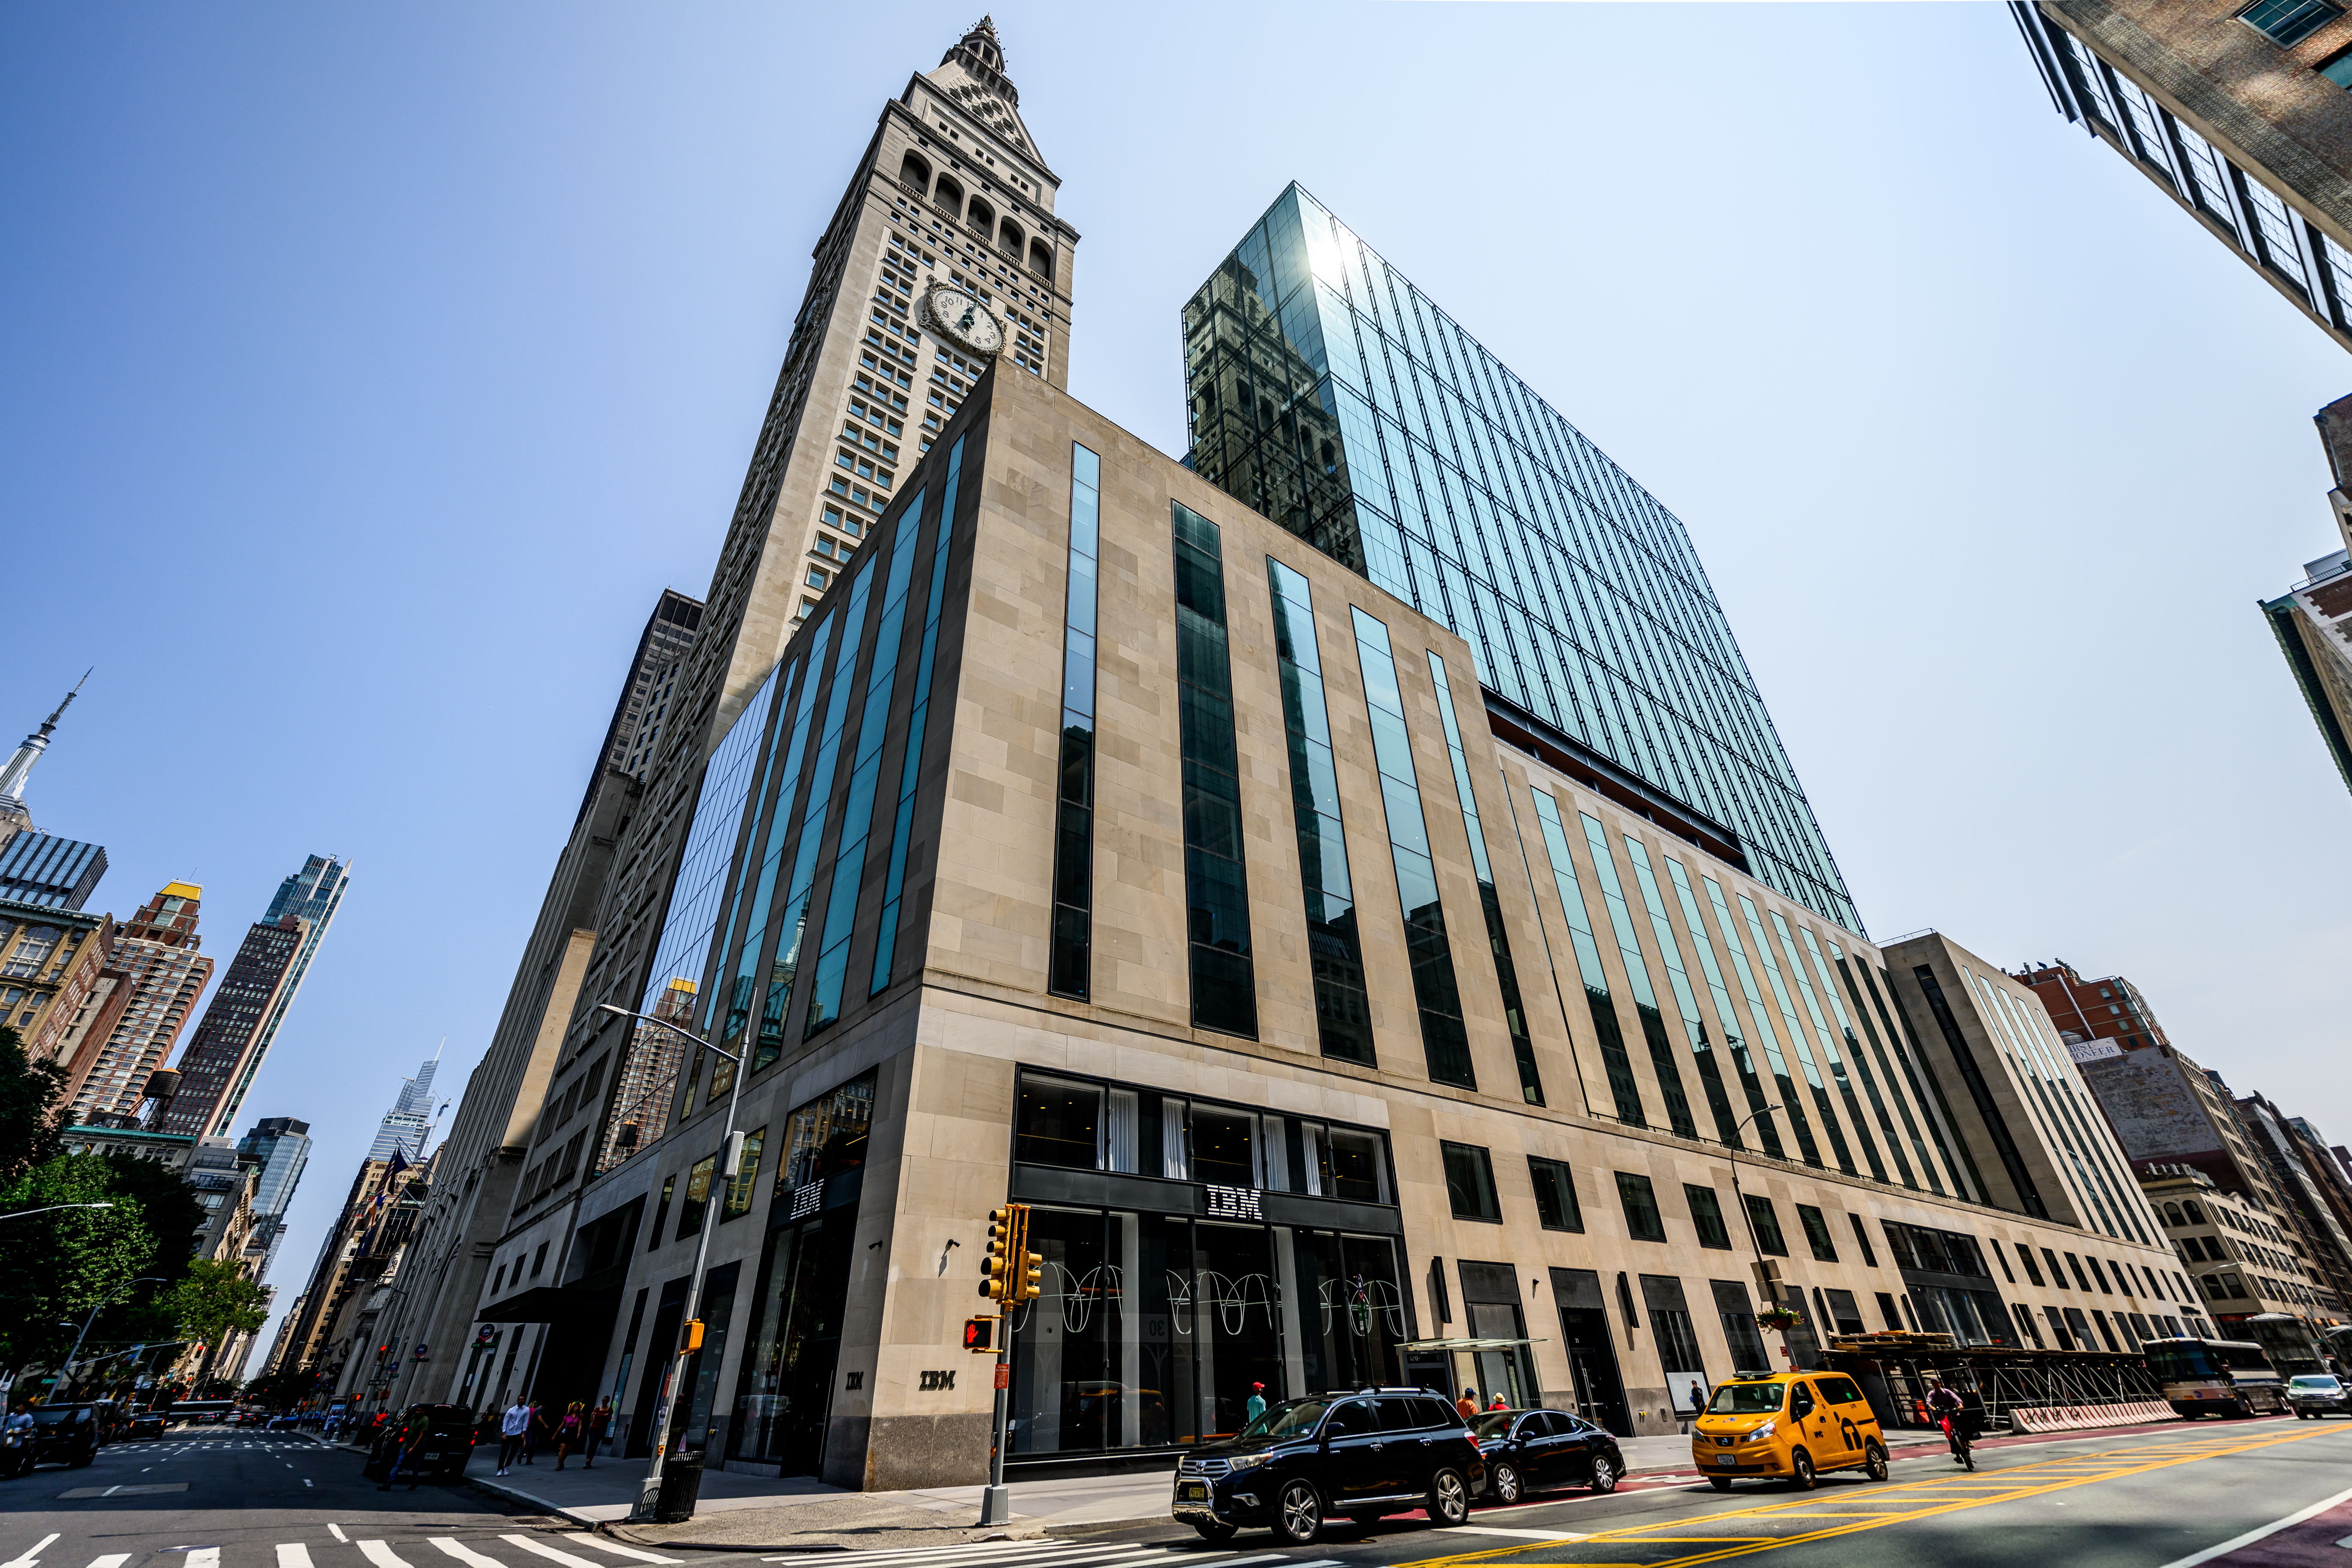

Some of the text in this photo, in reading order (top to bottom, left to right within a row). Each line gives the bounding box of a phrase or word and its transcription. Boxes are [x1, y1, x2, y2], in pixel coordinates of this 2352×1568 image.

[945, 296, 954, 305] 10
[956, 297, 962, 305] 11
[987, 322, 993, 330] 2
[975, 336, 981, 344] 5
[2066, 1042, 2092, 1053] IRST
[2069, 1046, 2115, 1060] IONEER
[790, 1178, 825, 1220] IBM
[1207, 1184, 1262, 1220] IBM
[845, 1371, 864, 1390] IBM
[919, 1370, 956, 1391] IBM
[1813, 1431, 1824, 1439] NYC
